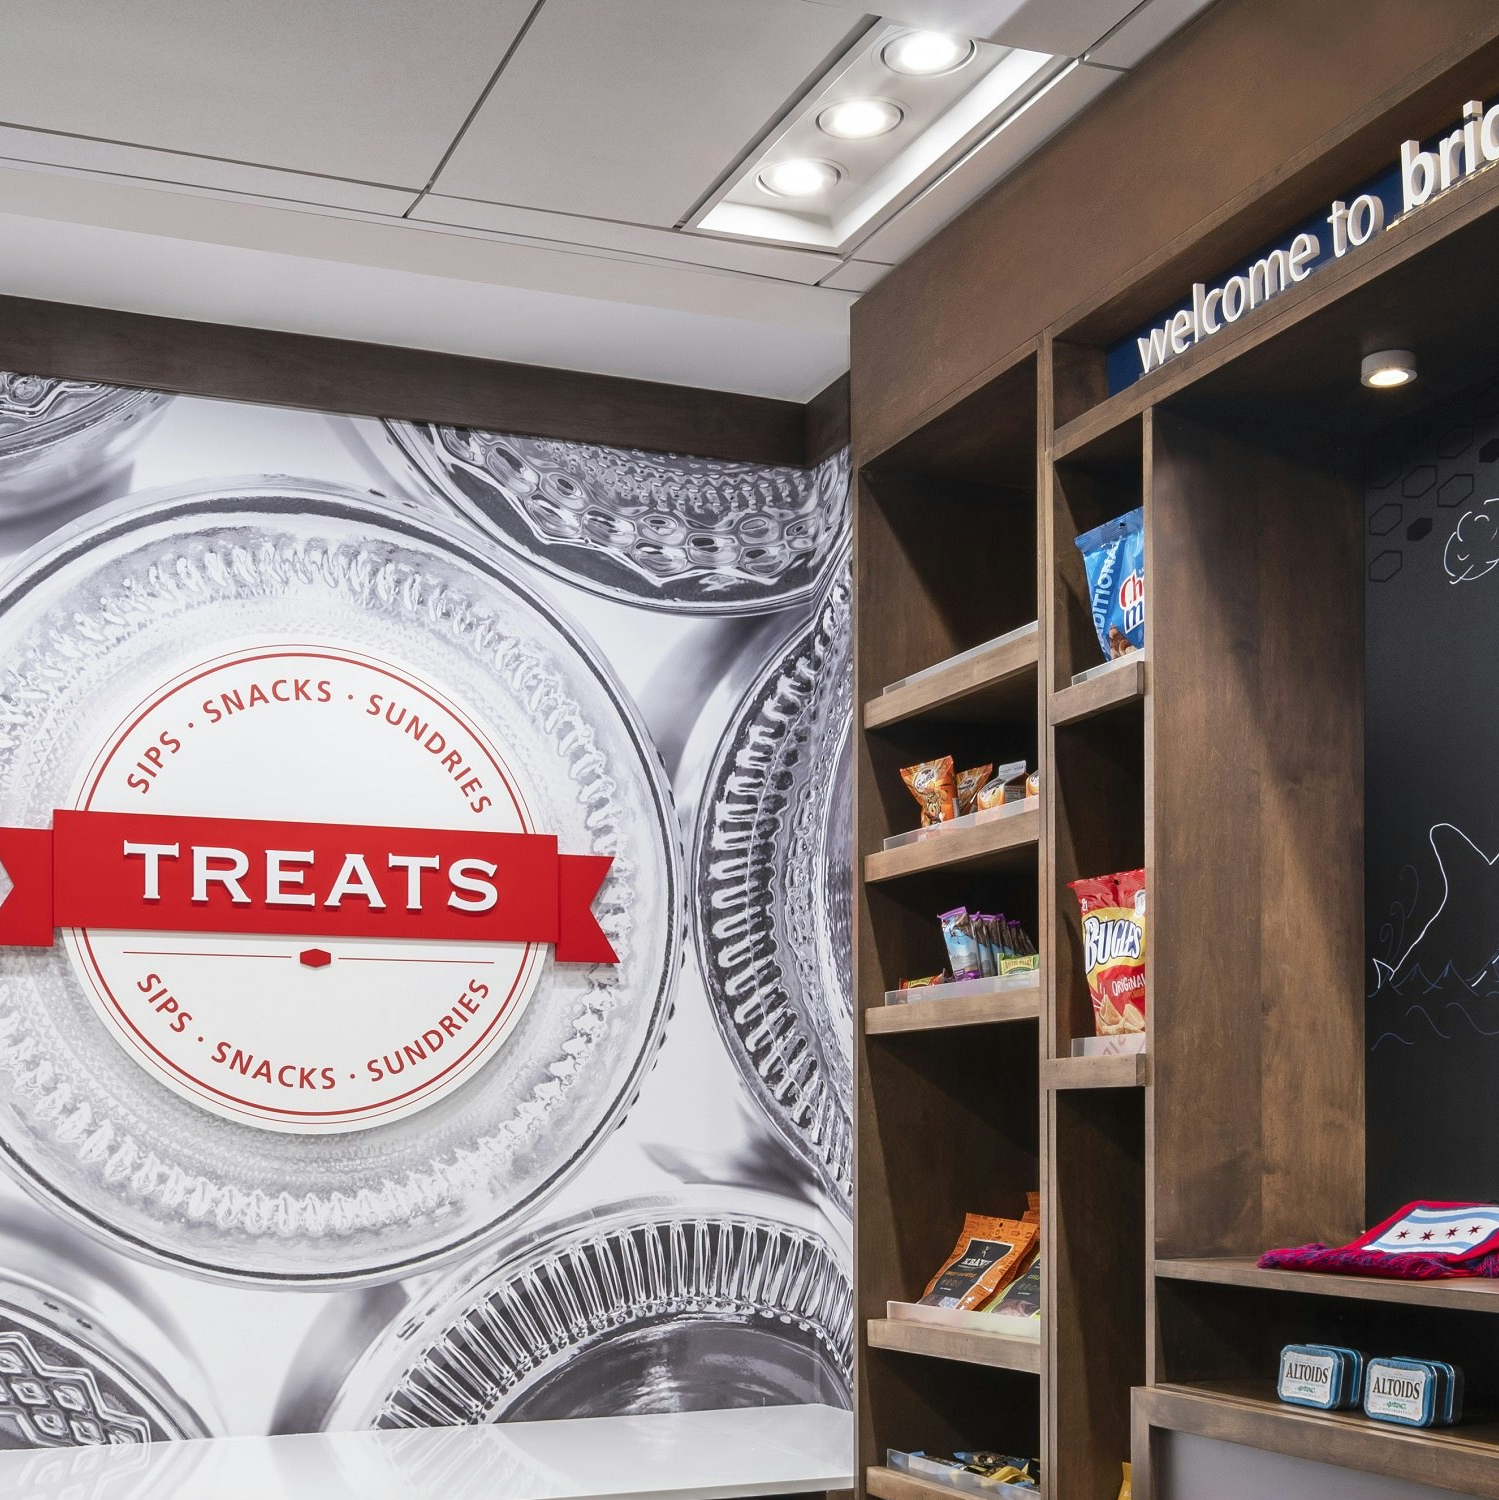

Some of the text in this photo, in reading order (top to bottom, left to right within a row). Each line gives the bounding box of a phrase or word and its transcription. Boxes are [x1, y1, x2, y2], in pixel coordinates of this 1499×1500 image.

[1136, 232, 1320, 374] welcome
[1327, 194, 1385, 258] to
[127, 679, 493, 815] SIPS SNACKS SUNDRIES
[123, 839, 499, 913] TREATS
[1083, 915, 1143, 975] BUGLES
[137, 972, 491, 1090] SIPS SNACKS SUNDRIES
[1285, 1362, 1329, 1385] ALTOIDS
[1372, 1377, 1421, 1400] ALTOIDS
